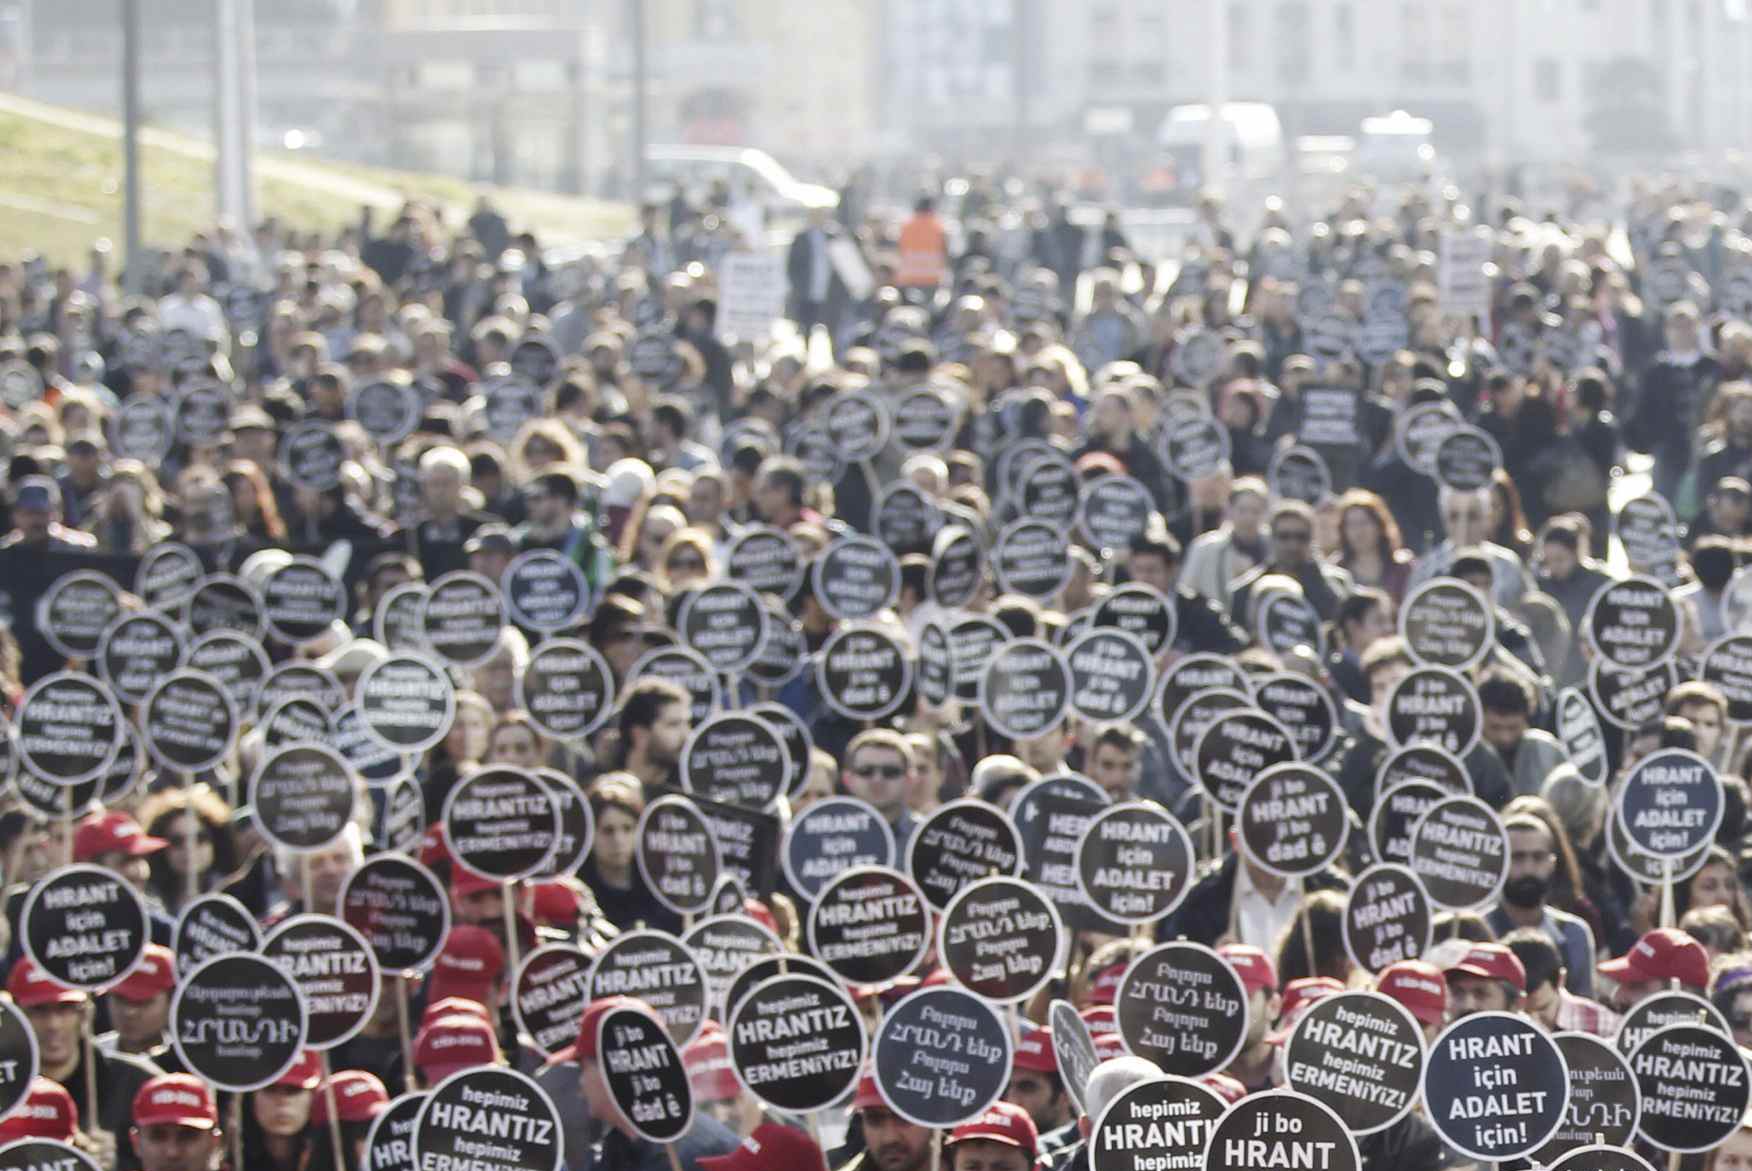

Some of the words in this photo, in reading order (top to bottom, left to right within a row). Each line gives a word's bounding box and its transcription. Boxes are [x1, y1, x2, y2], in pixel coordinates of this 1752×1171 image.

[757, 994, 820, 1015] hepimiz
[737, 1002, 850, 1044] HRANTIZ
[1335, 1006, 1398, 1035] hepimiz
[766, 1038, 829, 1059] hepimiz
[1304, 1017, 1418, 1071] HRANTIZ
[1449, 1033, 1535, 1060] HRANT
[1320, 1051, 1385, 1085] hepimiz
[1474, 1065, 1517, 1090] için
[462, 1085, 529, 1111] hepimiz
[1449, 1091, 1547, 1119] ADALET
[431, 1102, 553, 1145] HRANTIZ
[1475, 1122, 1527, 1149] için!
[454, 1136, 521, 1162] hepimiz
